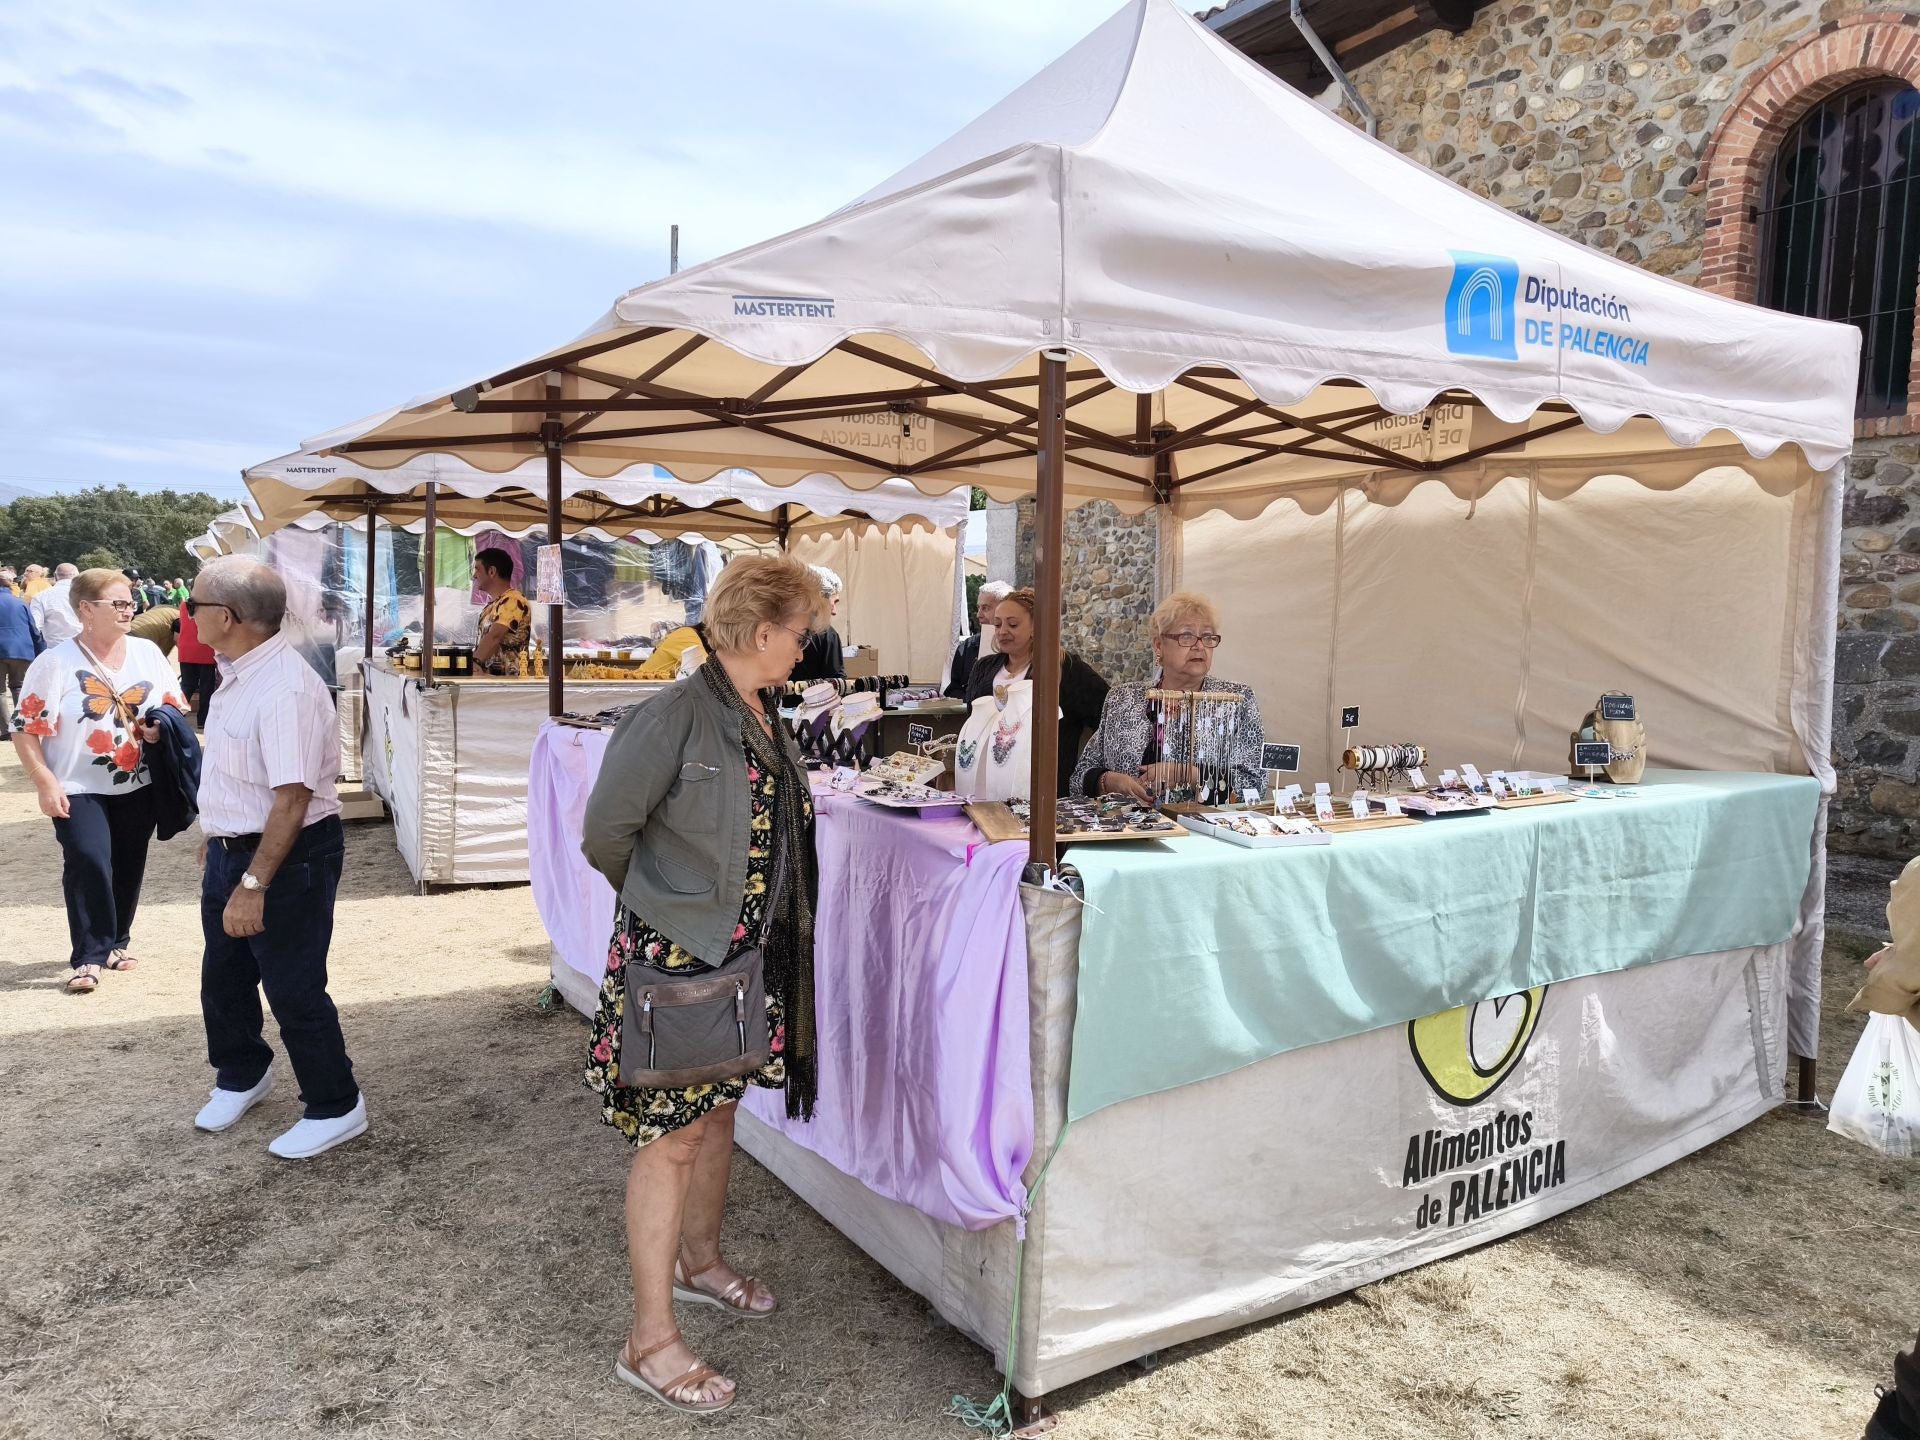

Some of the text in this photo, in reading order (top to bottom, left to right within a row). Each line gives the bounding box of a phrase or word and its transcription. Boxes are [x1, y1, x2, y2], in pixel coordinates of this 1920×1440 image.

[734, 302, 834, 318] MASTERTENT
[1524, 276, 1631, 322] Diputación
[1524, 318, 1650, 366] DE PALENCIA
[1403, 1110, 1533, 1187] Alimentos
[1416, 1139, 1566, 1230] de PALENCIA
